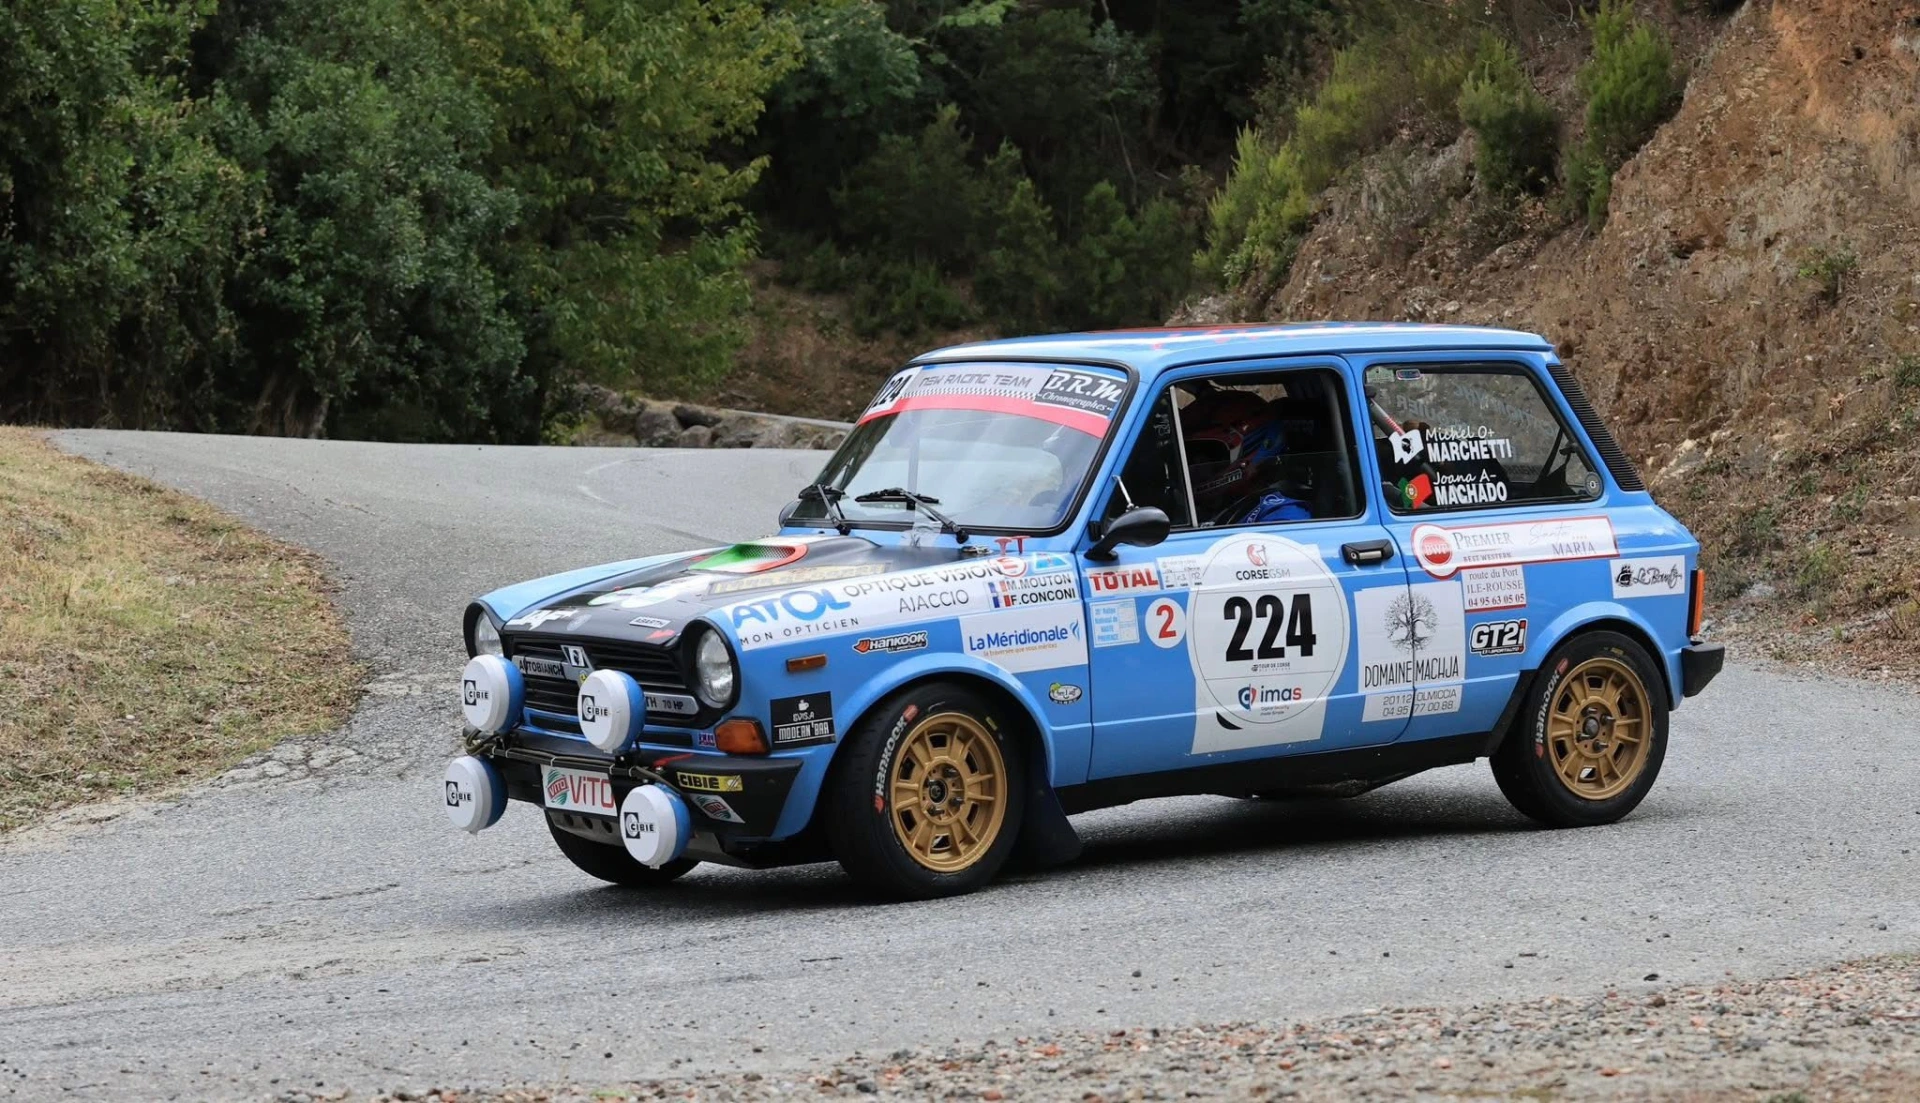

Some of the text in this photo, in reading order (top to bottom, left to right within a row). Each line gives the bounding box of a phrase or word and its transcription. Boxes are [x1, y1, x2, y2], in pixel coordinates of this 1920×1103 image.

[944, 373, 991, 386] RACING
[993, 374, 1033, 388] TEAM
[1426, 425, 1475, 442] Michel
[1427, 438, 1512, 463] MARCHETTI
[1433, 470, 1477, 486] Joana
[1434, 481, 1508, 506] MACHADO
[1452, 530, 1515, 550] PREMIER
[1552, 541, 1597, 556] MARIA
[1481, 552, 1512, 561] WESTERN
[843, 572, 934, 597] OPTIQUE
[934, 562, 1003, 583] VISION
[1006, 573, 1072, 590] M.MOUTON
[1088, 568, 1159, 591] TOTAL
[1469, 568, 1519, 580] route du Port
[1011, 588, 1076, 605] F.CONCONI
[1466, 581, 1524, 594] ILE-ROUSSE
[732, 589, 851, 629] ATOL
[899, 589, 969, 613] AJACCIO
[1468, 594, 1525, 607] 04 95 63 05 05
[1156, 604, 1177, 639] 2
[1223, 593, 1317, 662] 224
[740, 617, 859, 646] MON OPTICIEN
[969, 625, 1068, 651] La Méridionale
[1471, 619, 1527, 649] GT2i
[1364, 660, 1412, 688] DOMAINE
[1260, 685, 1302, 702] imas
[1382, 688, 1457, 706] 20112 OLMICCIA
[1382, 707, 1394, 717] 04
[1396, 705, 1409, 715] 95
[1413, 703, 1426, 713] 77
[1427, 701, 1440, 711] 00
[679, 774, 721, 790] CIBIE
